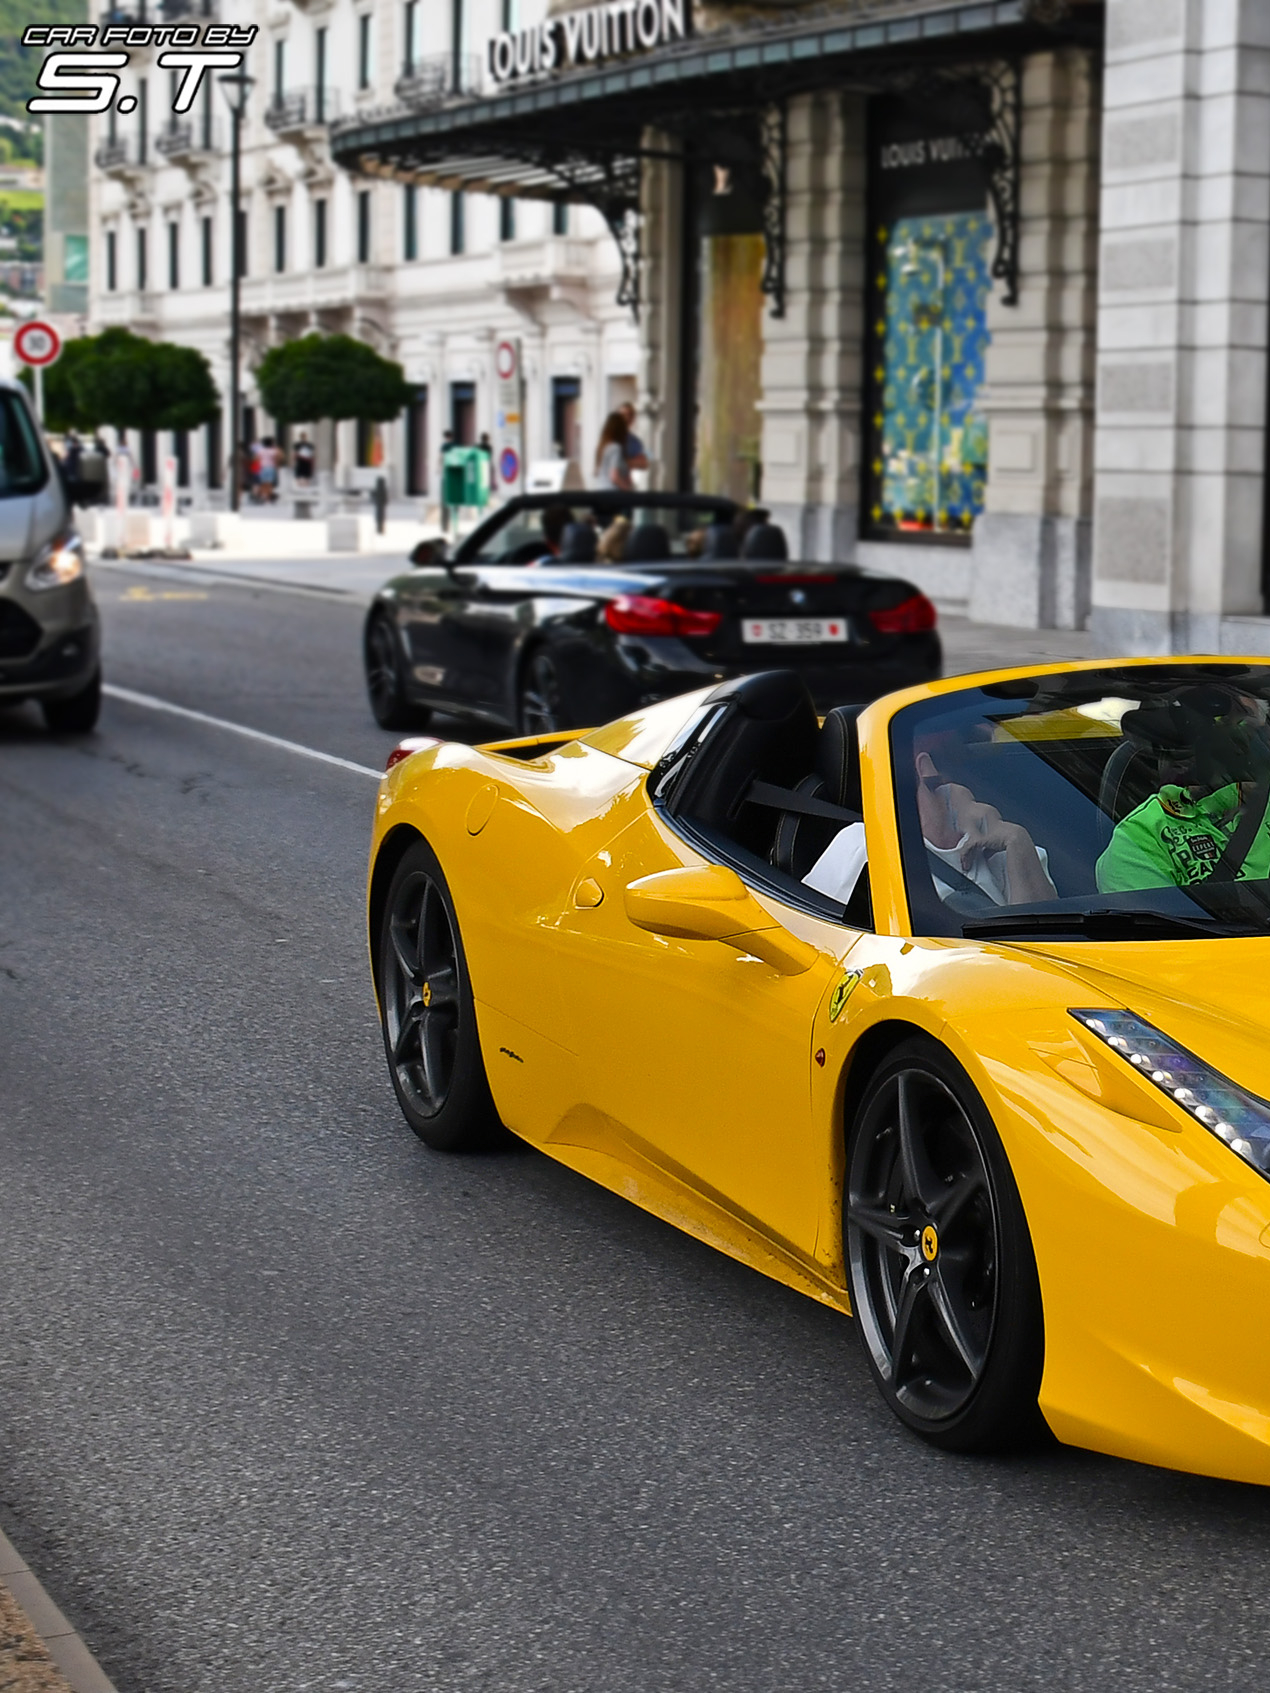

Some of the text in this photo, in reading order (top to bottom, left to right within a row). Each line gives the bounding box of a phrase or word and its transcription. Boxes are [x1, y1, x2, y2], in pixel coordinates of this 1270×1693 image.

[486, 0, 687, 84] LOUIS VUITTON
[881, 139, 926, 168] LOUIS
